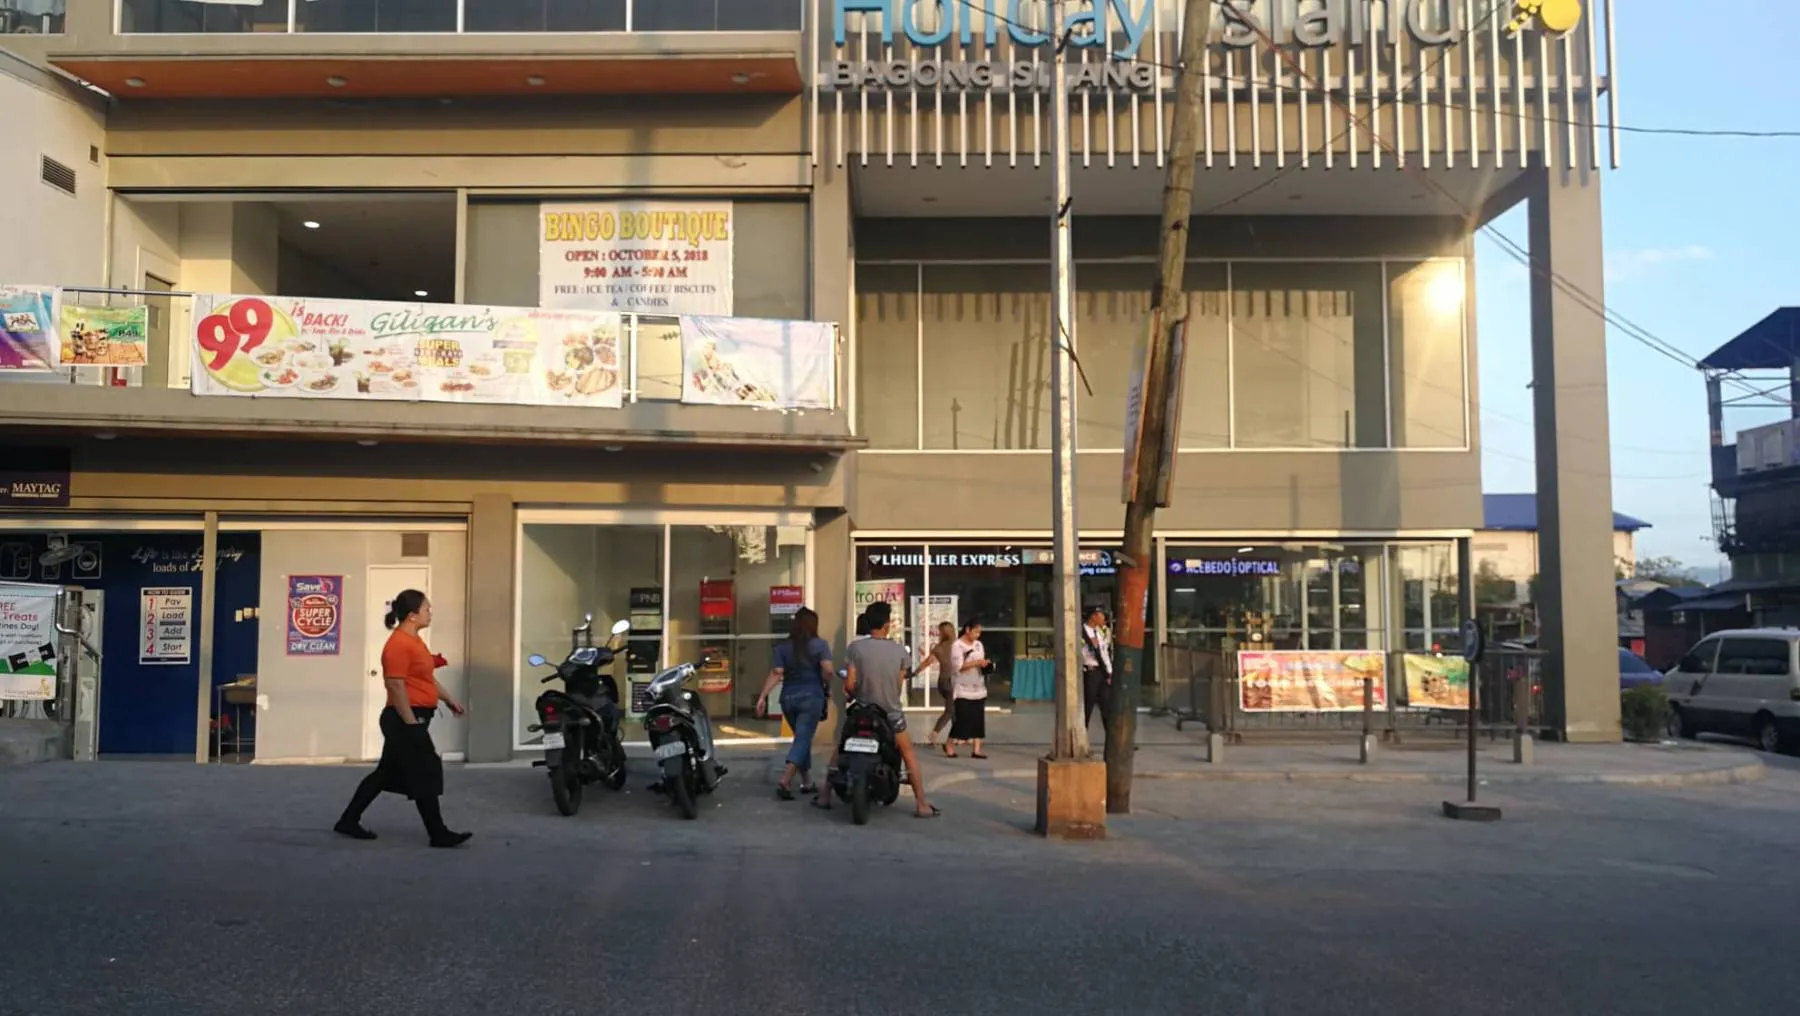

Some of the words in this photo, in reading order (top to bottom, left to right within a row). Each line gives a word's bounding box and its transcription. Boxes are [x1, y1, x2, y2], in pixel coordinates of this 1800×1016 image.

[1221, 0, 1459, 46] sland
[833, 59, 993, 88] BAGONG
[1012, 59, 1153, 92] SIANG
[545, 212, 615, 241] BINGO
[620, 211, 729, 248] BOUTIQUE
[565, 250, 598, 262] OPEN
[609, 250, 668, 262] OCTOBER
[684, 250, 709, 262] 2018
[612, 267, 632, 278] AM
[667, 267, 688, 278] AM
[303, 312, 348, 327] BACK!
[370, 308, 498, 336] Giligan's
[197, 298, 273, 371] 99
[12, 483, 61, 493] MAYTAG
[153, 562, 177, 573] loads
[179, 562, 190, 573] of
[1238, 561, 1281, 574] OPTICAL
[4, 612, 38, 621] Treats
[147, 613, 155, 625] 2
[162, 611, 184, 619] Load
[299, 608, 331, 617] SUPER
[21, 622, 39, 631] Day!
[297, 617, 332, 626] CYCLE
[147, 628, 154, 640] 3
[163, 627, 182, 635] Add
[146, 643, 154, 655] 4
[163, 643, 182, 651] Start
